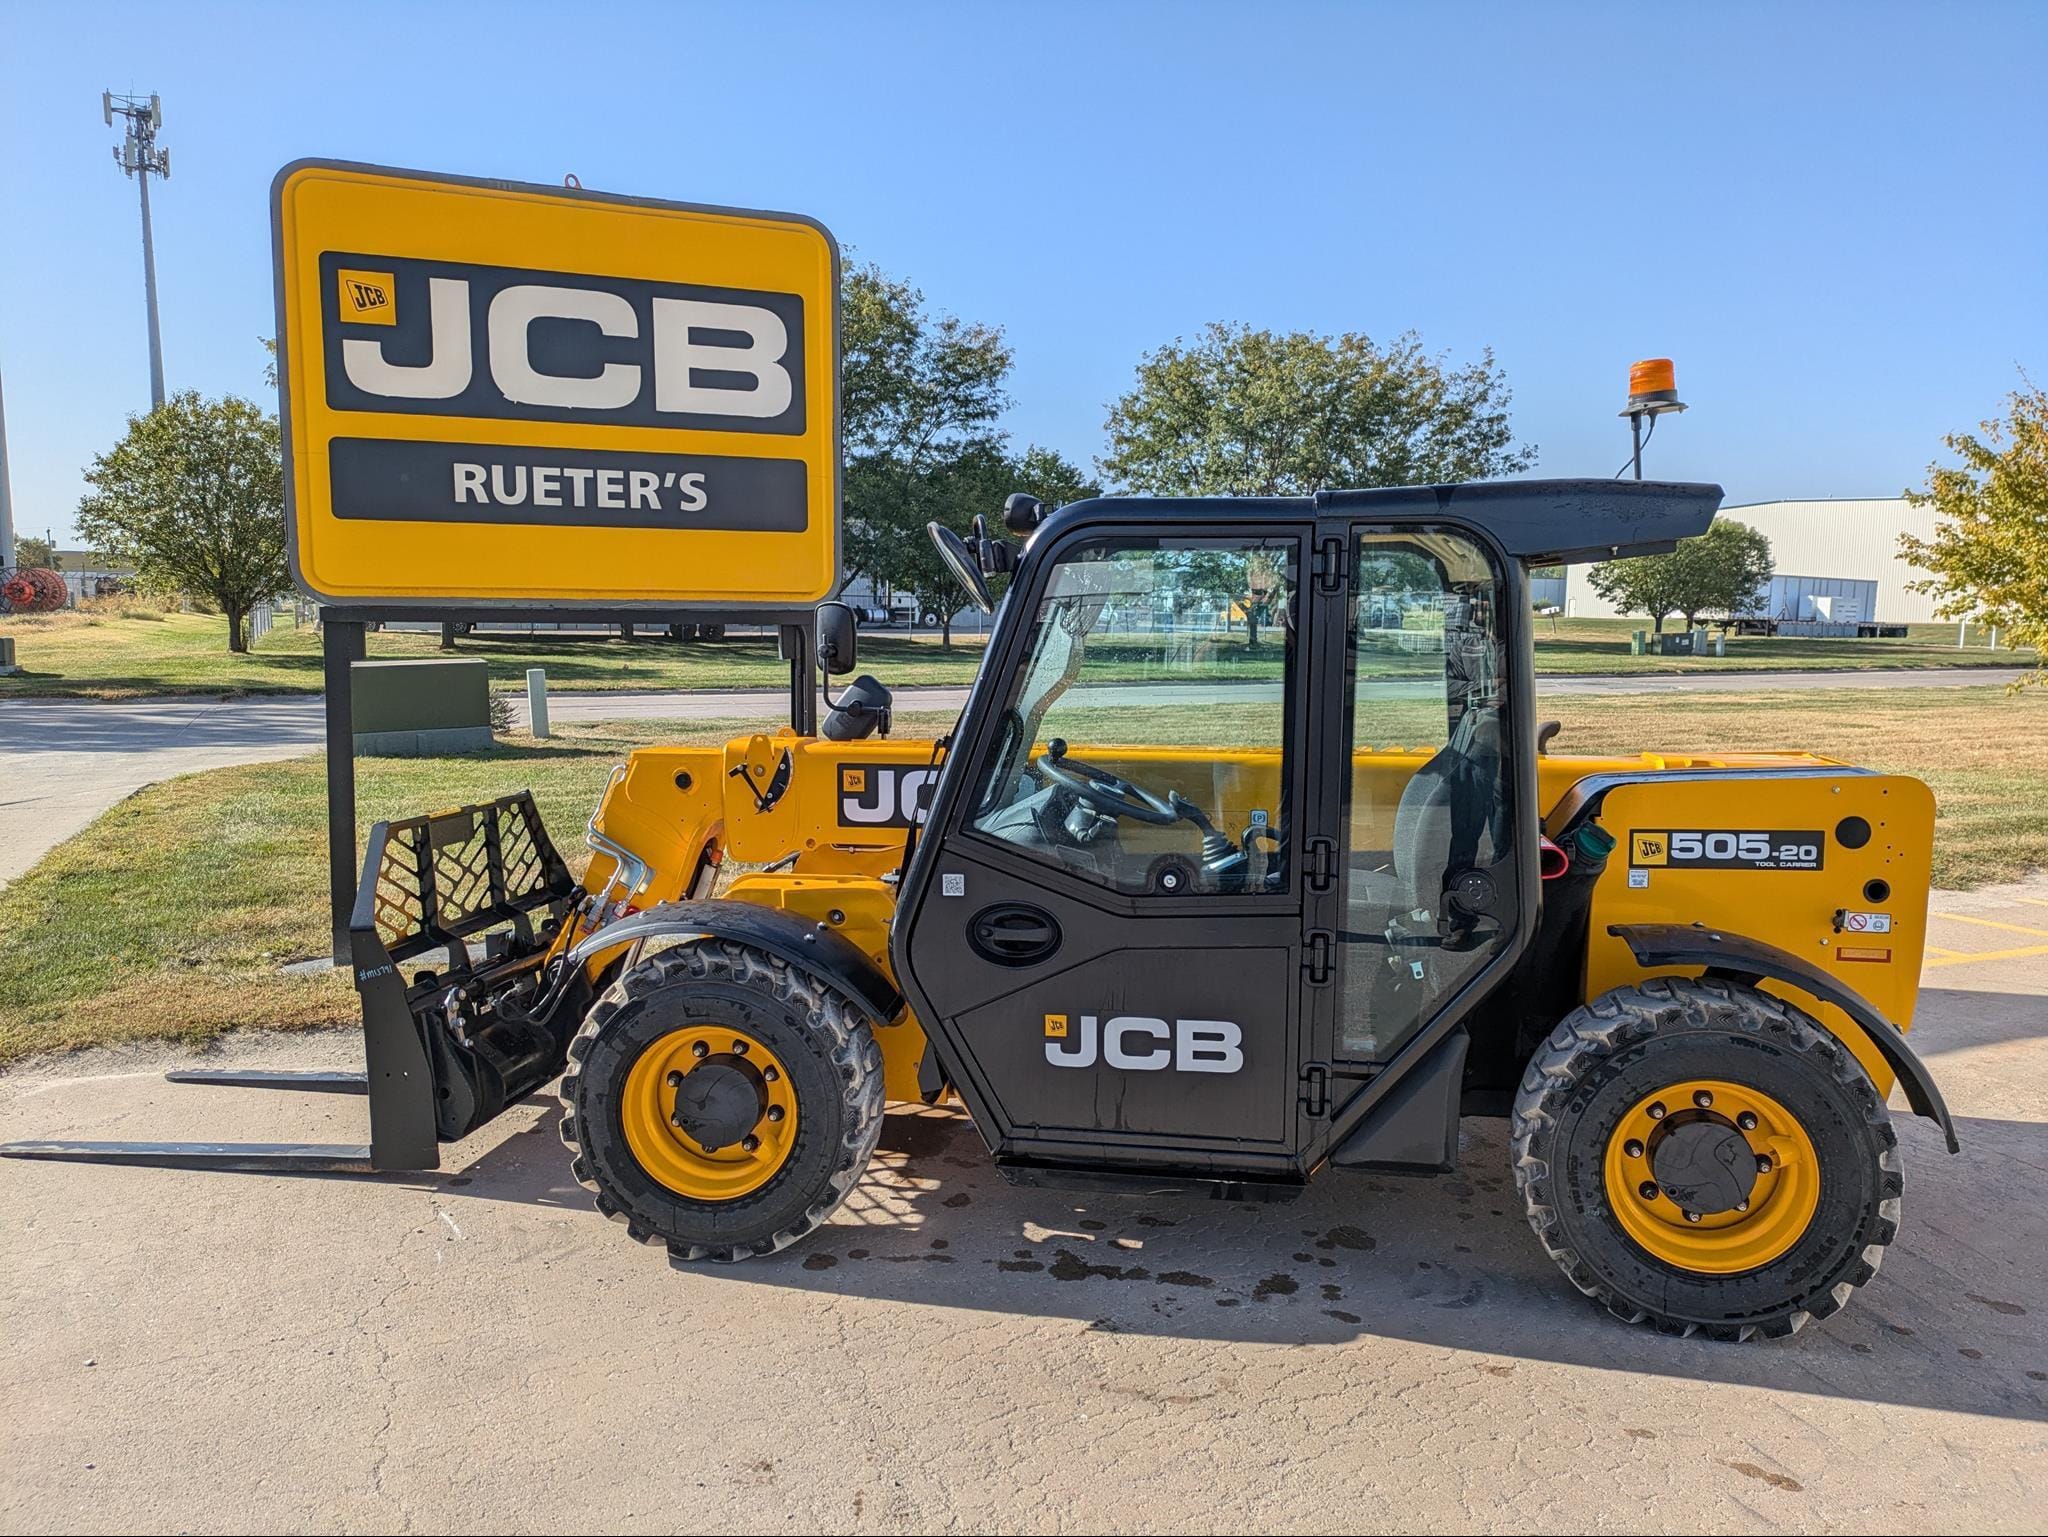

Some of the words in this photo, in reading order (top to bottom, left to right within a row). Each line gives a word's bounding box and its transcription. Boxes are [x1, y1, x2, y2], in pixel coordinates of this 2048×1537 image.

[354, 284, 386, 308] JCB
[342, 277, 792, 418] JCB
[453, 463, 707, 512] RUETER'S
[843, 770, 938, 824] JC
[1642, 839, 1662, 857] JCB
[1671, 833, 1818, 861] 505-20
[1045, 1016, 1244, 1073] JCB
